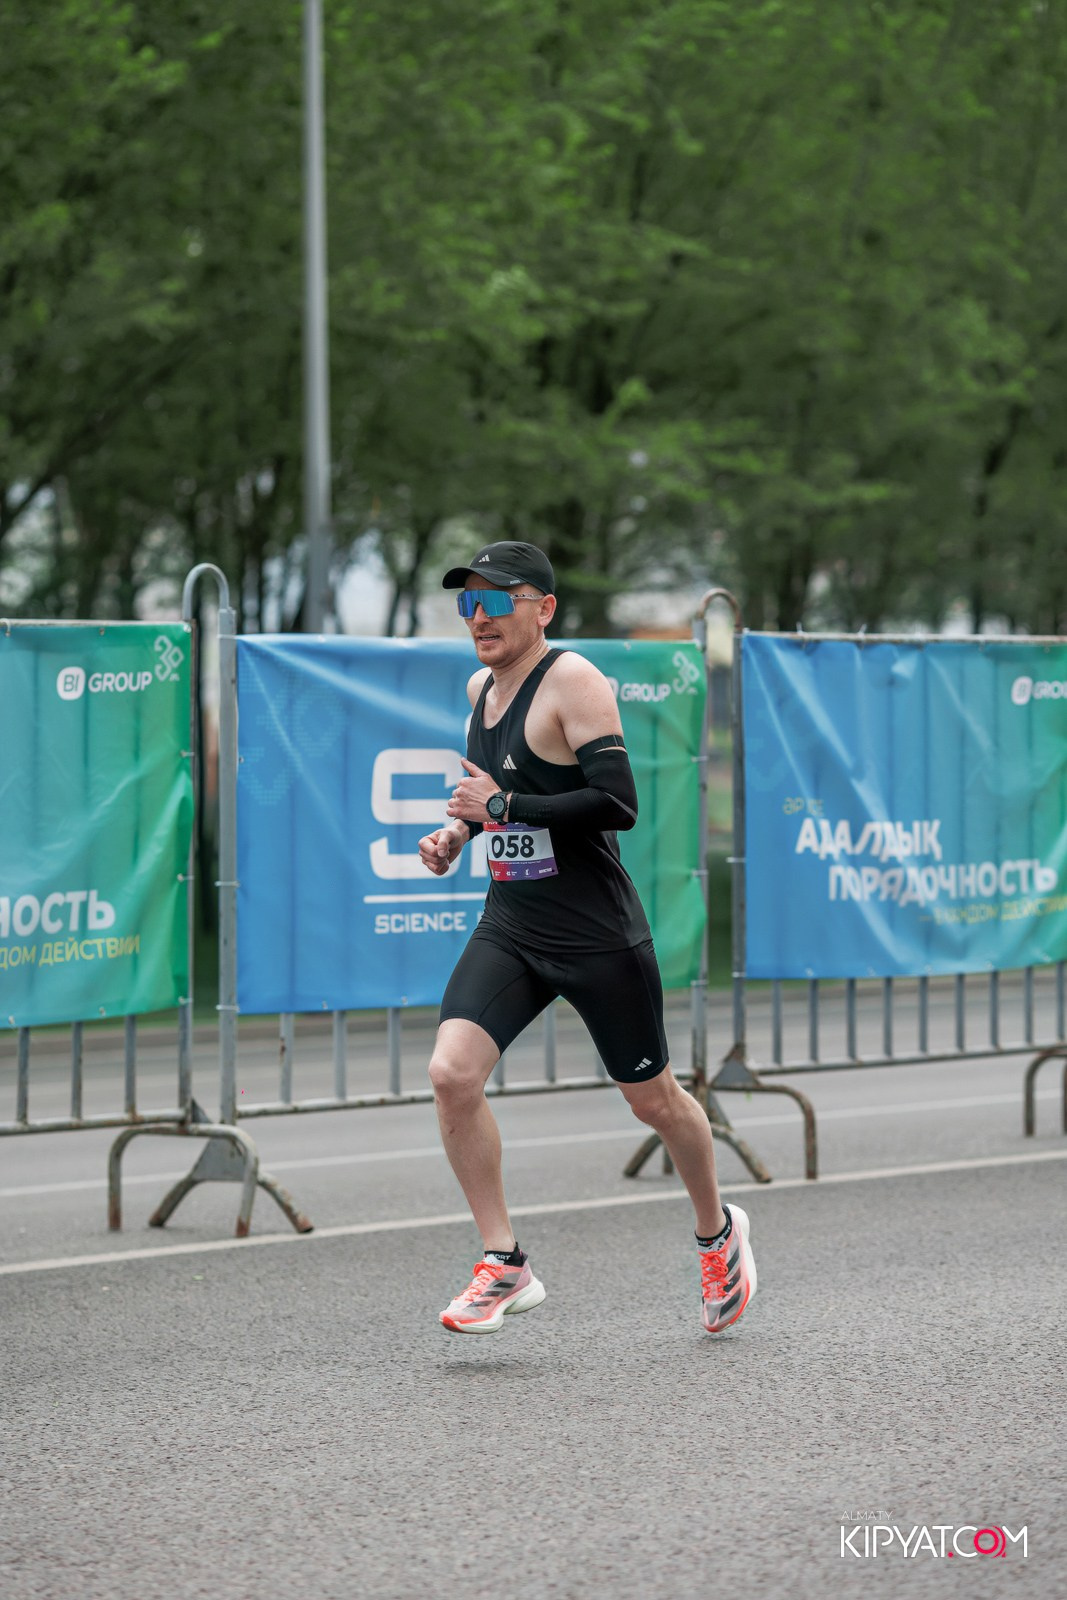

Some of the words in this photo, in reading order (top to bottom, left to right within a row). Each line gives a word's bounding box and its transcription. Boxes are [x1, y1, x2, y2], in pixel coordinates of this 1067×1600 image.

[88, 671, 153, 693] GROUP
[620, 683, 672, 702] GROUP
[491, 834, 535, 859] 058
[374, 911, 467, 935] SCIENCE
